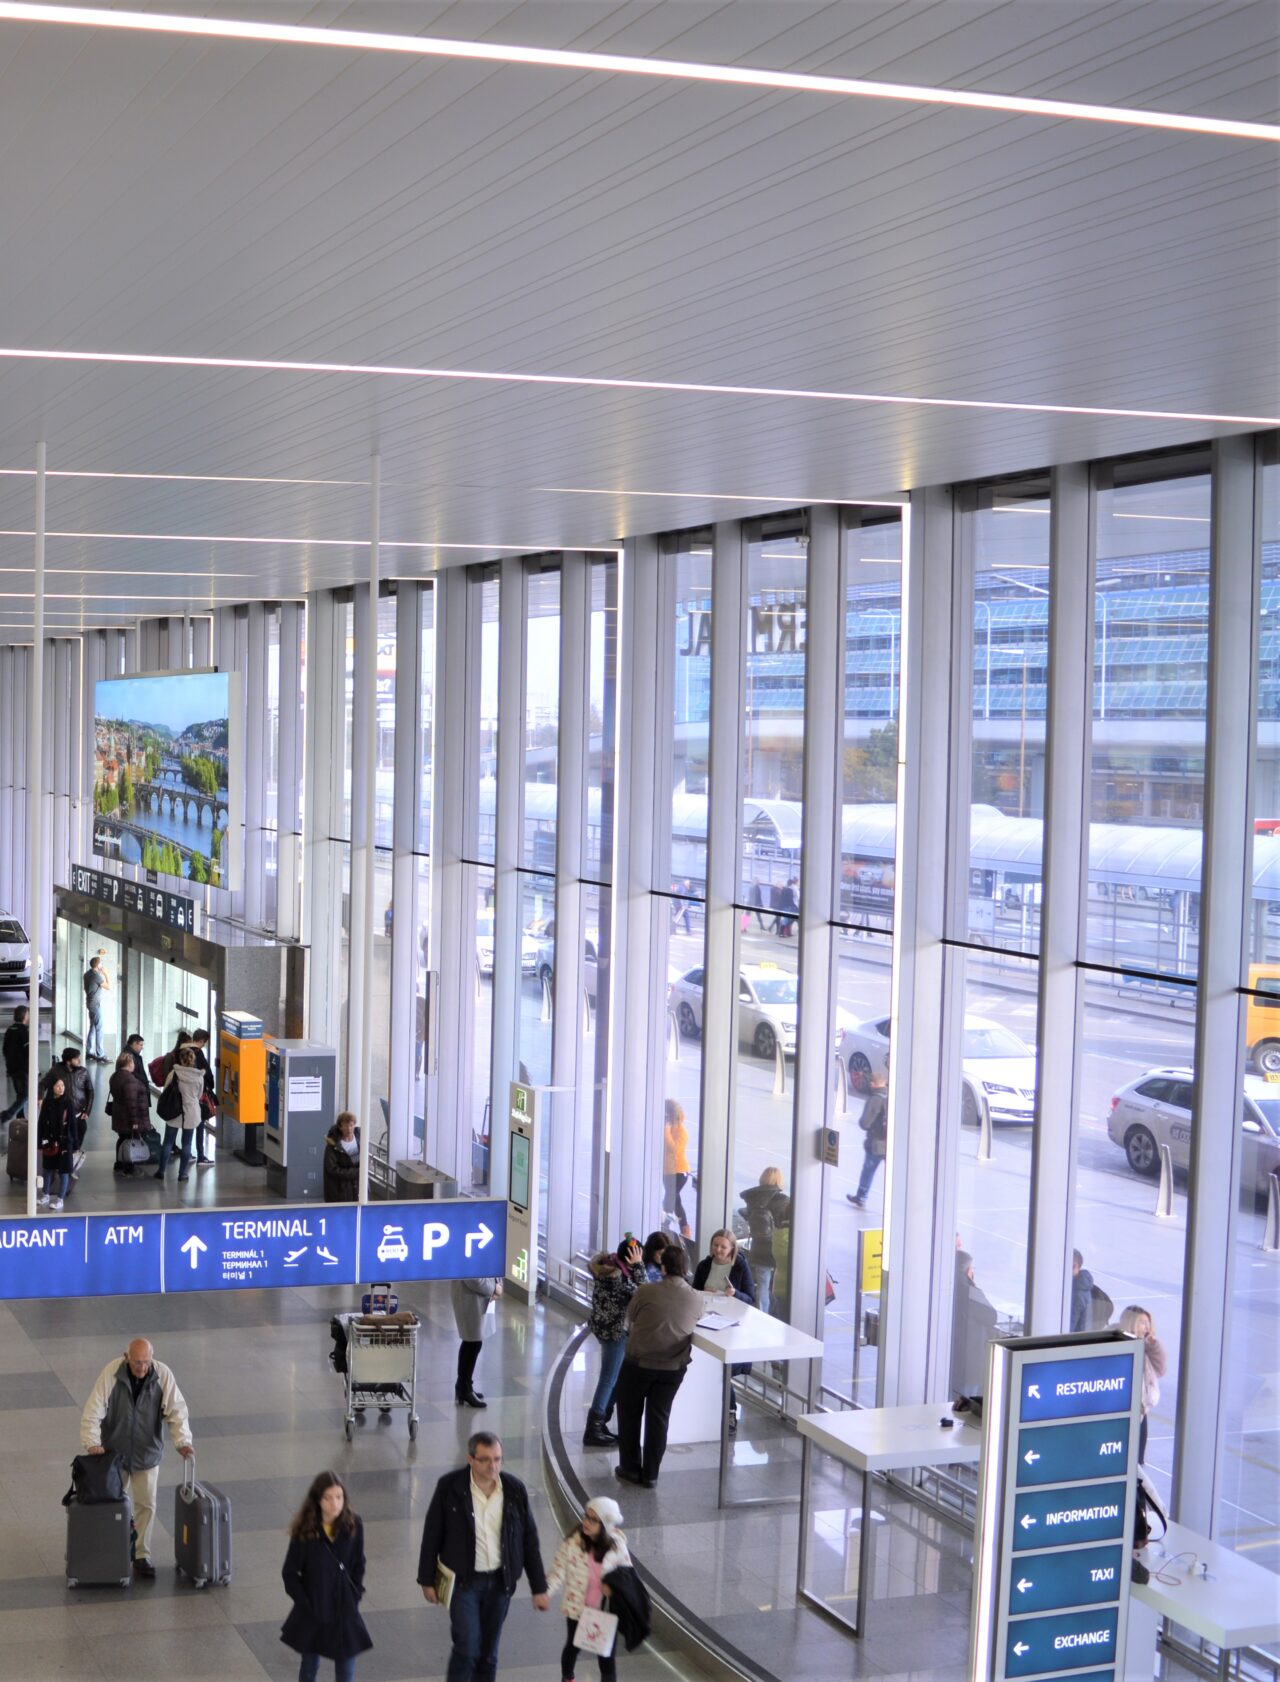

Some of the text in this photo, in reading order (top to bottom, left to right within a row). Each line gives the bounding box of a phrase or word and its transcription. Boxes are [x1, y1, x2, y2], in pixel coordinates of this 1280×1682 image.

[78, 869, 91, 893] EXIT
[104, 1226, 144, 1245] ATM
[222, 1218, 326, 1240] TERMINAL 1
[422, 1222, 450, 1261] P
[222, 1249, 259, 1260] TERMINÁL
[222, 1261, 263, 1270] ТЕРМИНАЛ
[222, 1271, 246, 1280] 터미널
[1056, 1377, 1125, 1396] RESTAURANT
[1099, 1441, 1122, 1456] ATM
[1046, 1505, 1118, 1526] INFORMATION
[1090, 1567, 1114, 1582] TAXI
[1054, 1630, 1110, 1649] EXCHANGE
